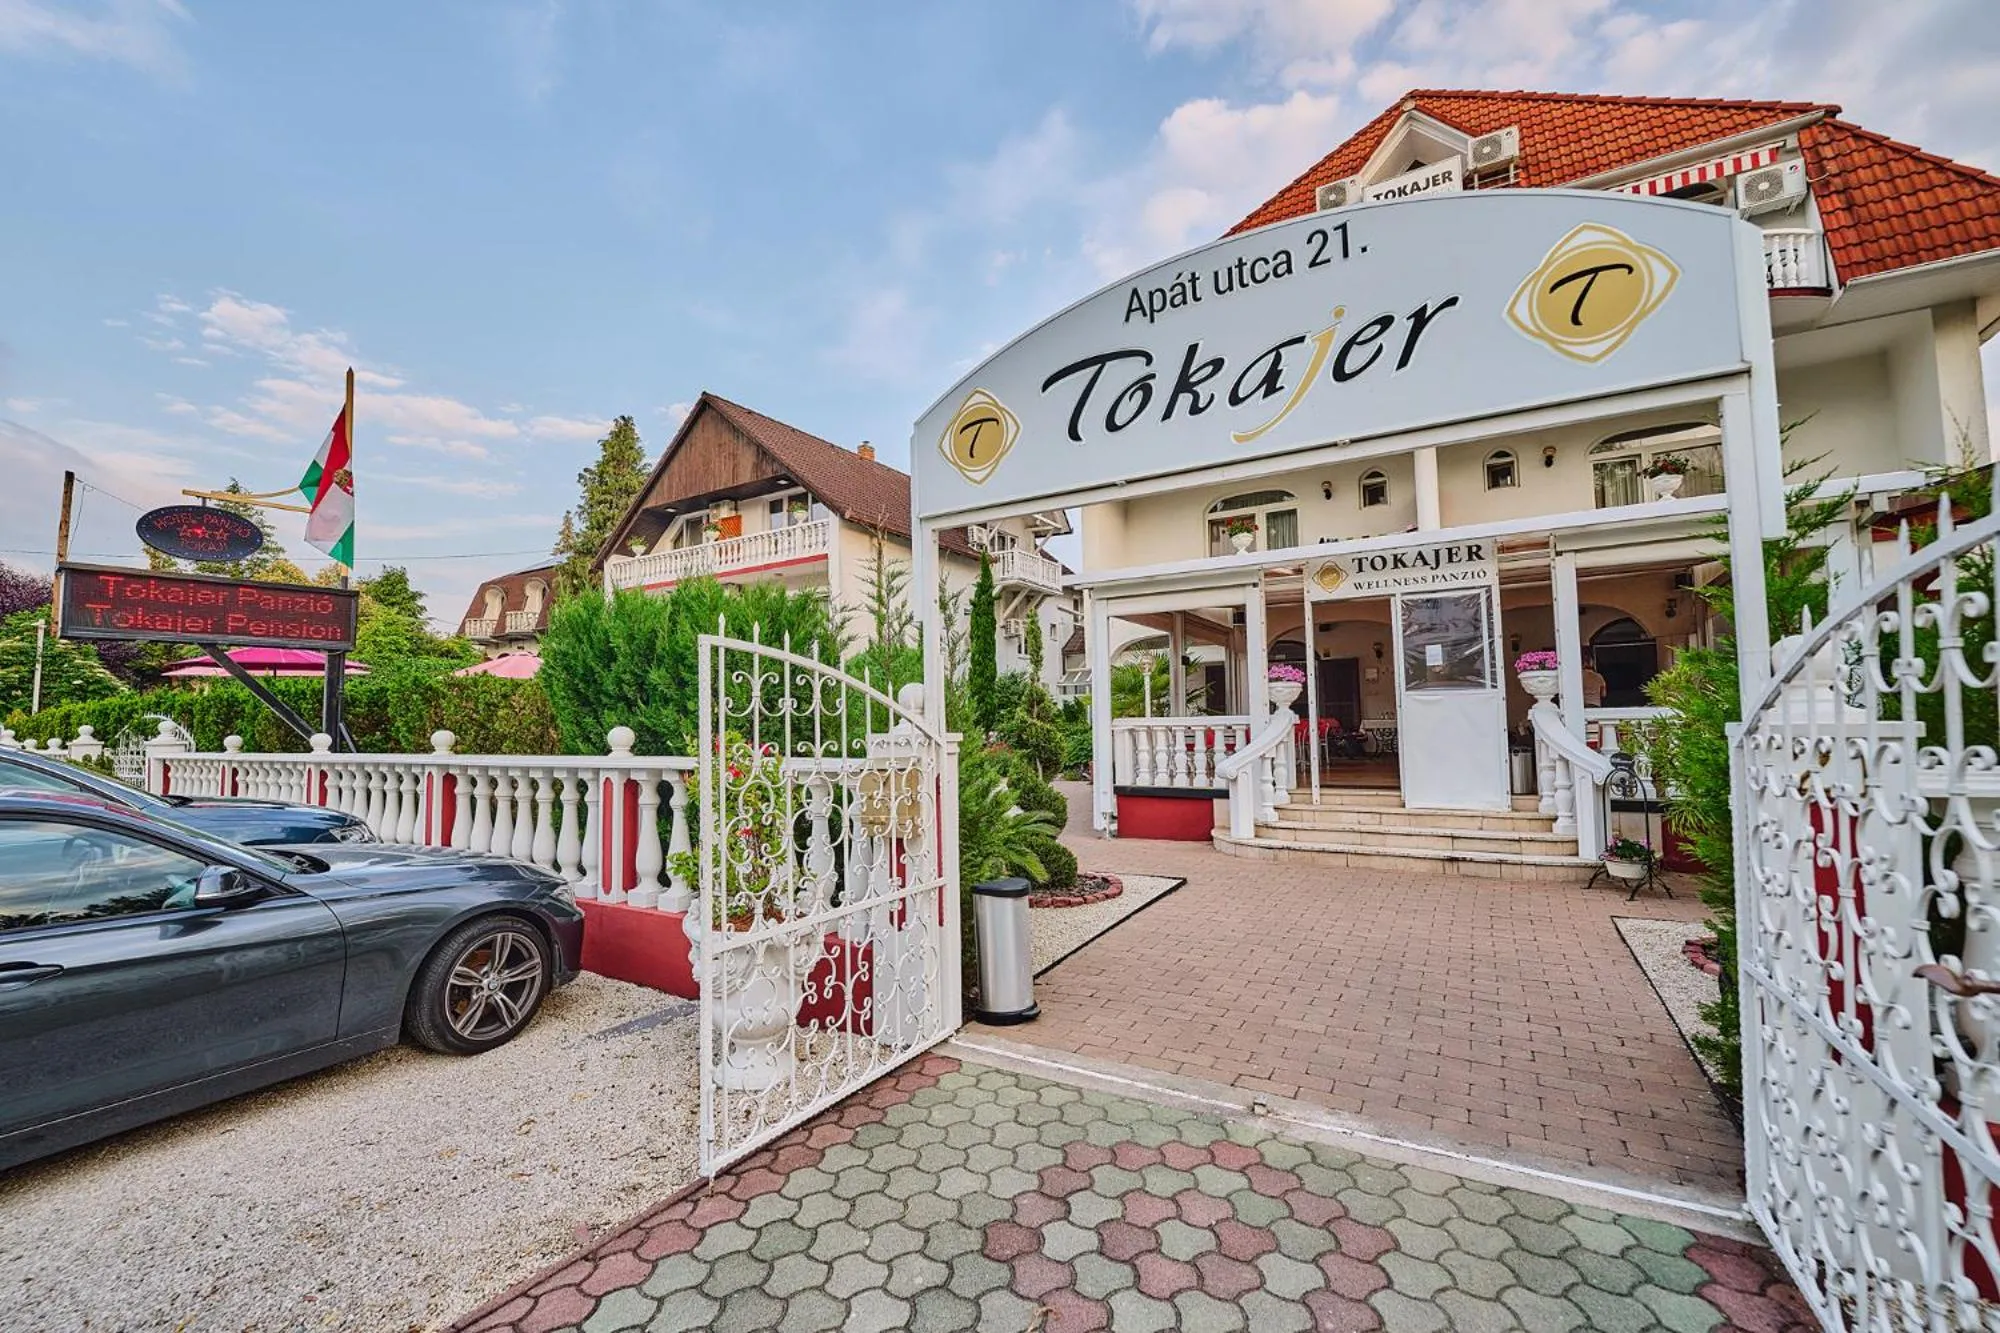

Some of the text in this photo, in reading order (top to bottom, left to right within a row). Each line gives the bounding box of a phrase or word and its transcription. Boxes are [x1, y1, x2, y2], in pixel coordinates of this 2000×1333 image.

[1124, 221, 1369, 324] Apát utca 21.
[1549, 263, 1634, 326] T
[1041, 295, 1460, 444] Tokajer
[959, 417, 1000, 459] T
[1352, 544, 1486, 574] TOKAJER
[99, 575, 334, 614] Tokajer Panzió
[1354, 568, 1488, 591] WELLNESS PANZIÓ
[85, 603, 341, 640] Tokajer Pension
